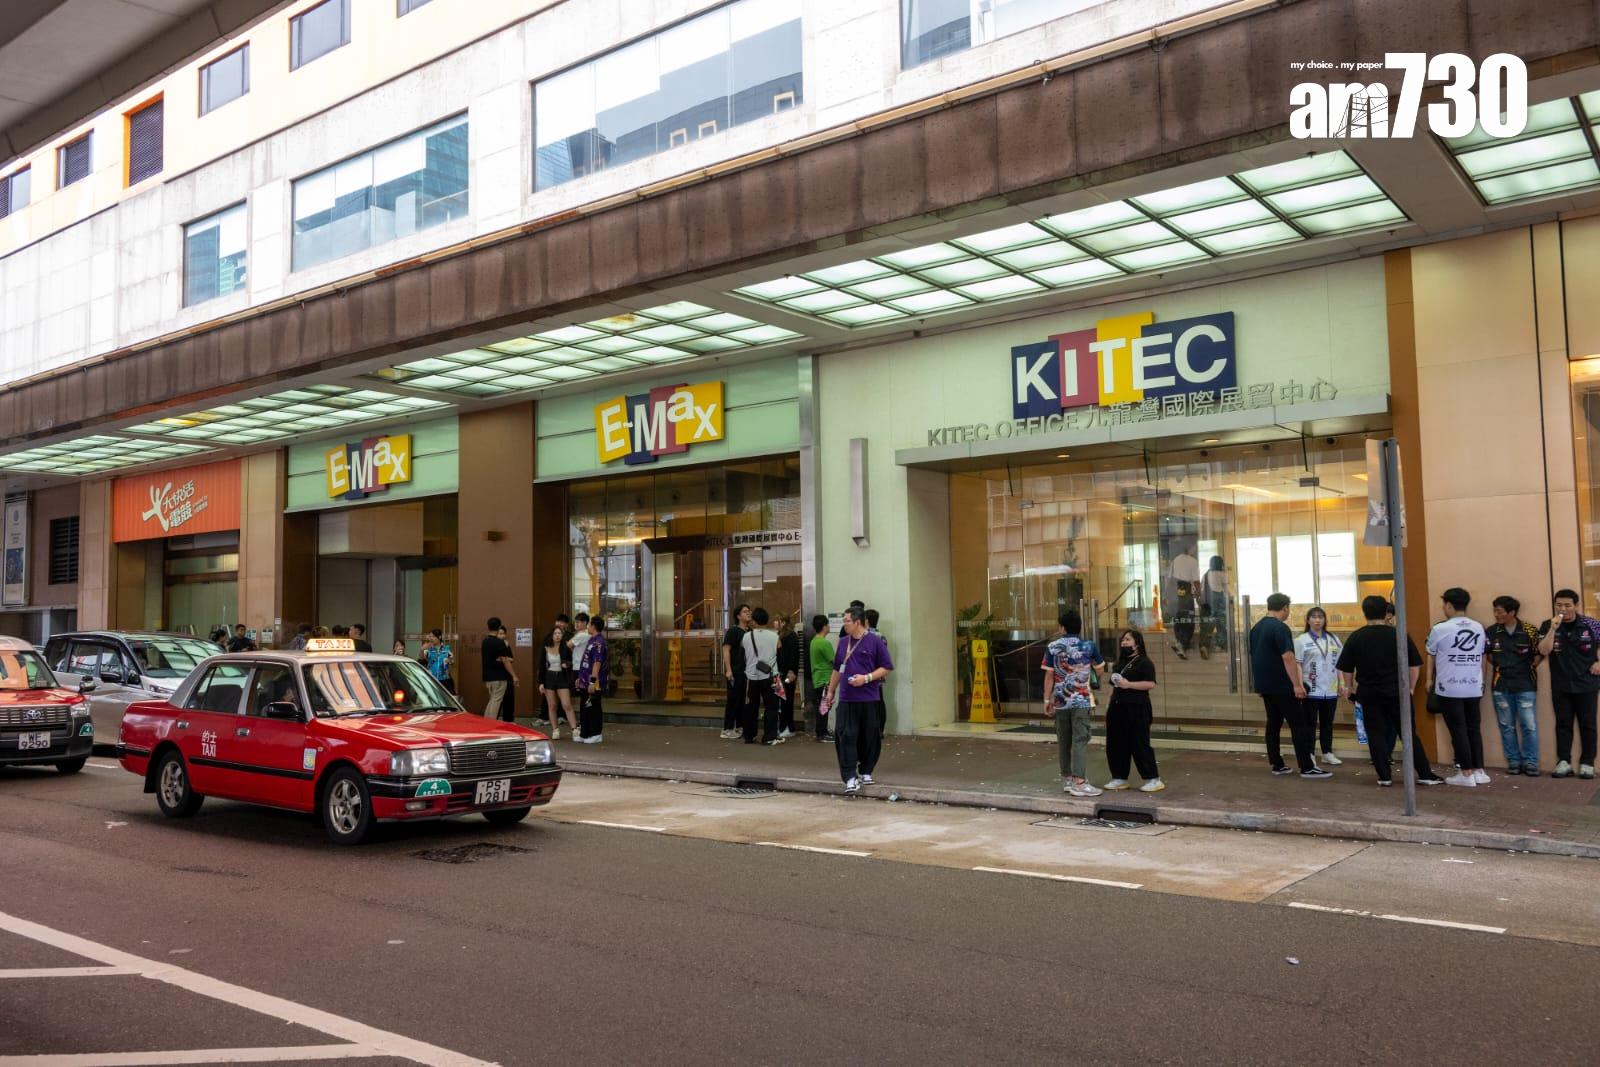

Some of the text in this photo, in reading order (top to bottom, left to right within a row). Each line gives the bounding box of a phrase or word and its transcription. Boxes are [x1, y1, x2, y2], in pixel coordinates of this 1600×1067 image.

[1016, 324, 1228, 404] KITEC
[928, 378, 1338, 447] KITEC OFFICE 九龍灣國際展貿中心
[315, 639, 352, 648] TAXI
[1447, 654, 1481, 663] ZERO
[201, 730, 217, 744] 的士
[21, 740, 48, 750] 9290
[201, 742, 217, 757] TAXI
[430, 782, 438, 790] 4
[486, 780, 502, 793] PS
[479, 790, 506, 804] 1281
